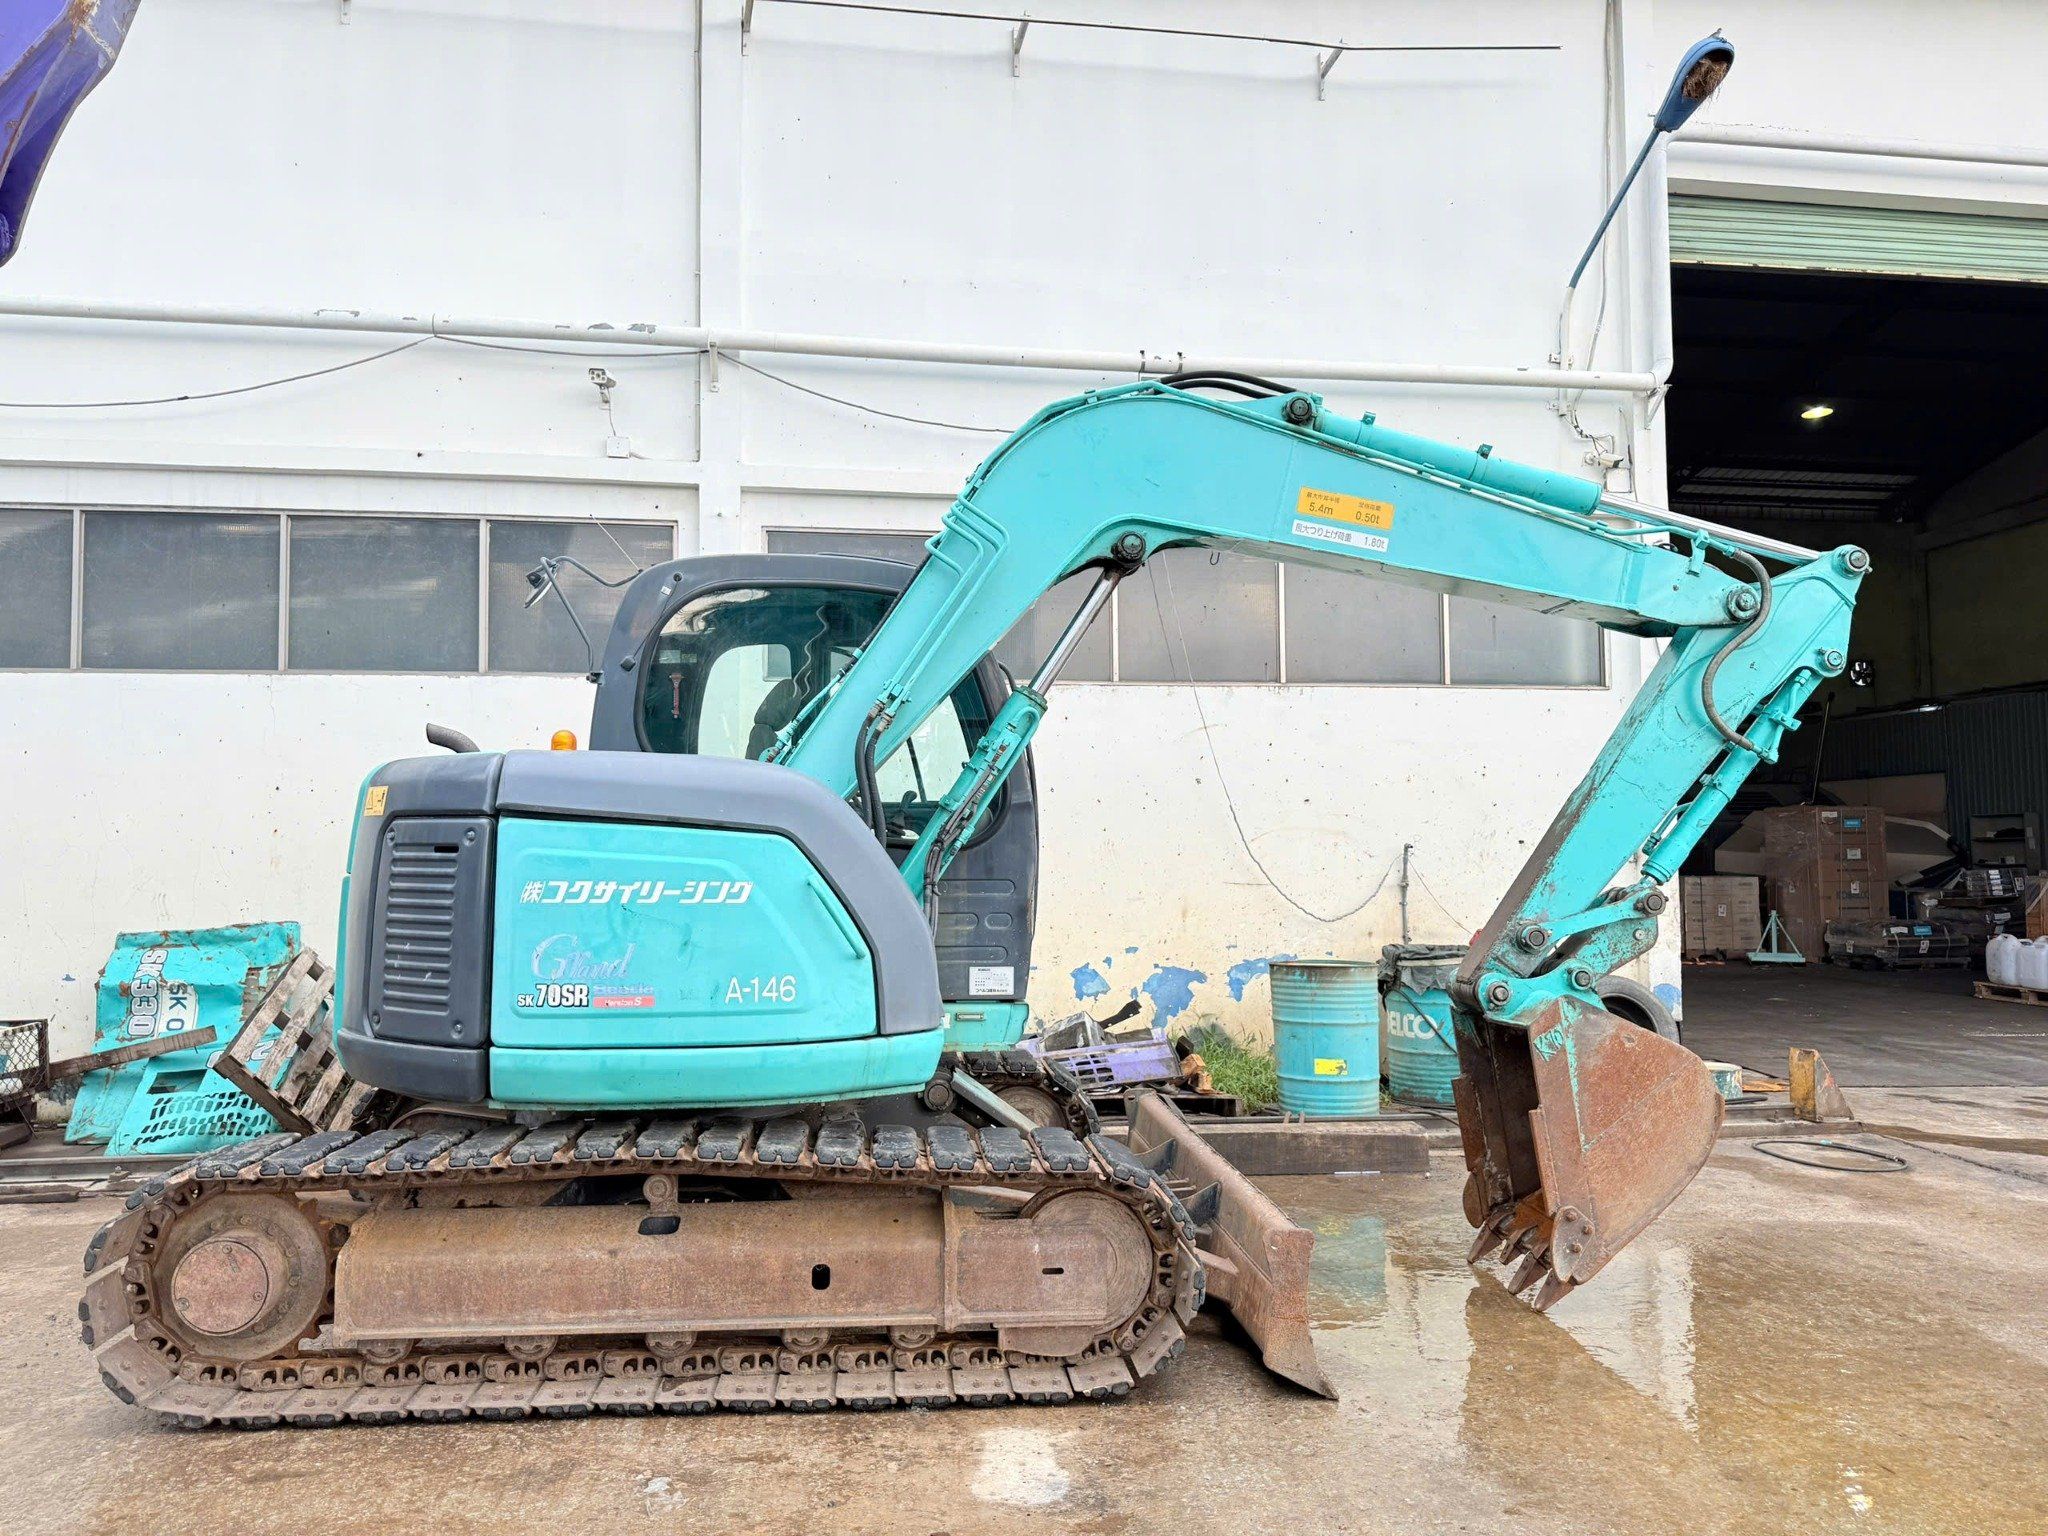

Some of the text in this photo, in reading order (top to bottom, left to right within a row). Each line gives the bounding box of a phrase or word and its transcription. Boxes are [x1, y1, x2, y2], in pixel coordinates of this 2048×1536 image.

[1308, 501, 1333, 516] 5.4m
[1355, 510, 1381, 525] 0.50t
[1363, 536, 1386, 549] 1.80t
[724, 974, 797, 1004] A-146
[1387, 1010, 1437, 1040] ELCO
